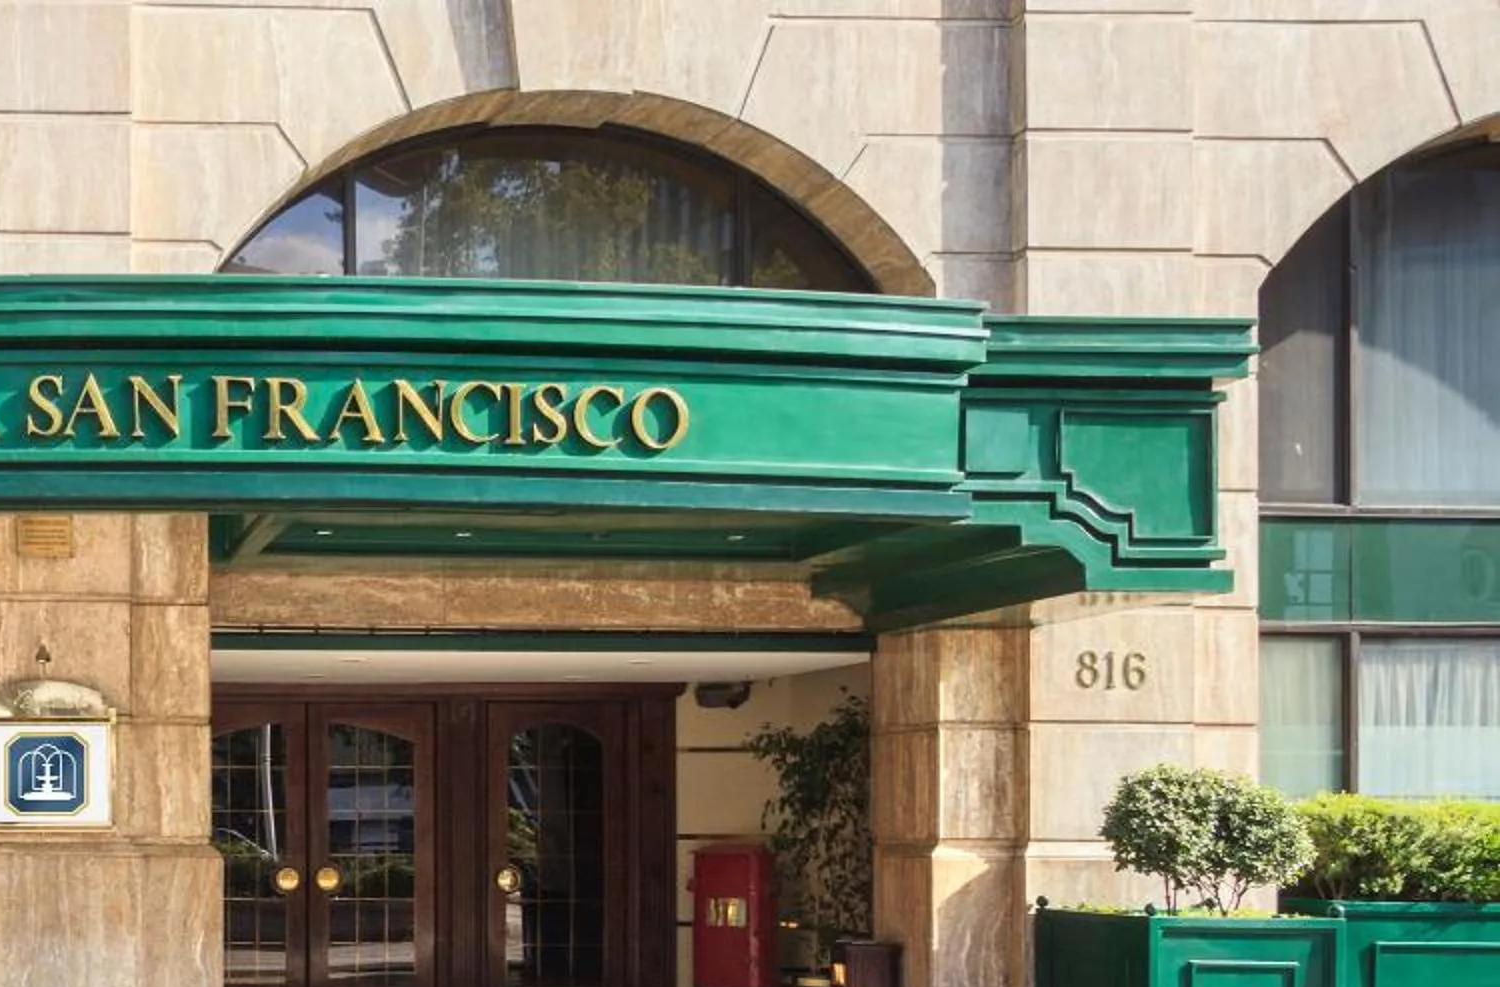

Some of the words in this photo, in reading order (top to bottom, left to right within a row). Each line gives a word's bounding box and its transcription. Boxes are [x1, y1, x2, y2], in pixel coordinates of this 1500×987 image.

[25, 371, 184, 439] SAN
[211, 375, 691, 450] FRANCISCO
[1075, 650, 1146, 690] 816
